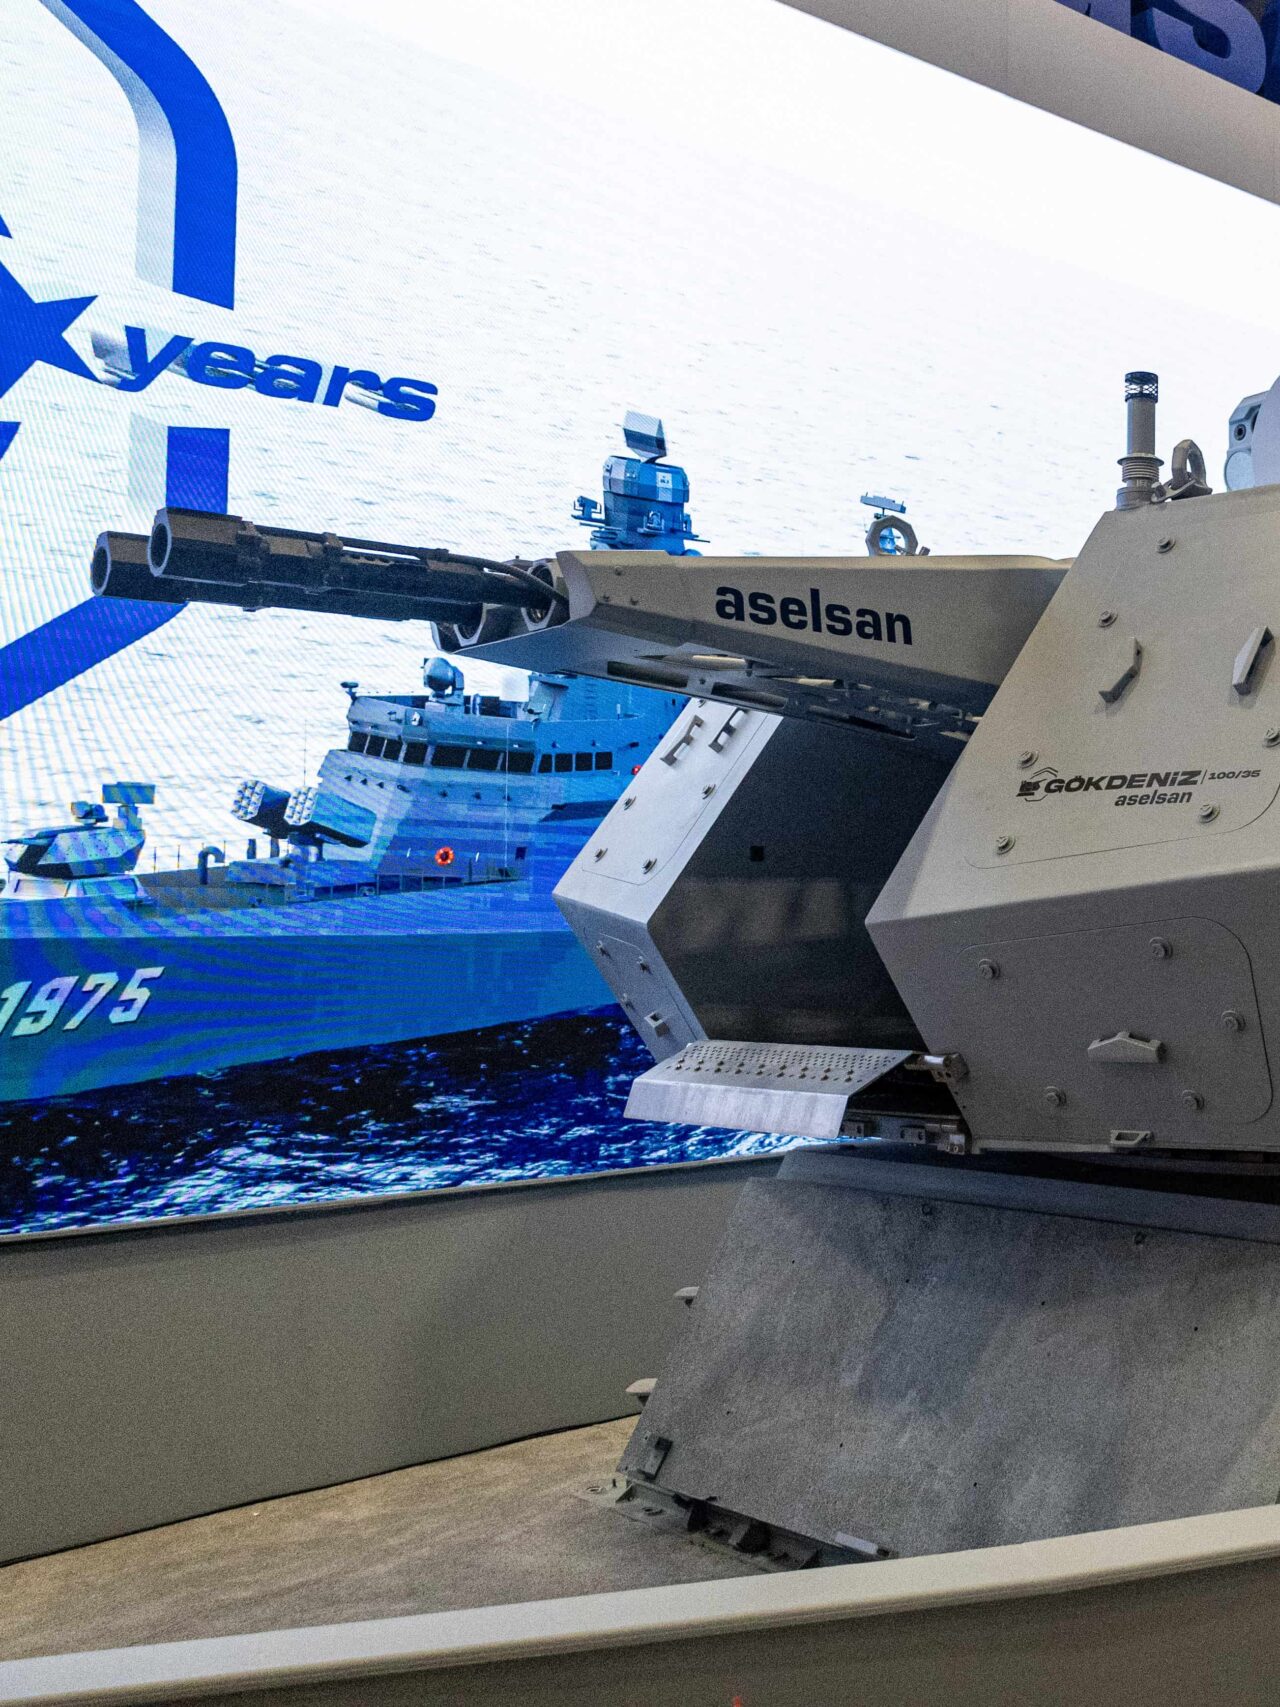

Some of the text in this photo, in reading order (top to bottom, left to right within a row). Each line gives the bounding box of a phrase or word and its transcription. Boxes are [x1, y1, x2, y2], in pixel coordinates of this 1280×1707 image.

[113, 325, 439, 422] years
[715, 586, 913, 646] aselsan
[1114, 789, 1193, 807] aselsan
[1208, 769, 1262, 781] 100/35
[0, 966, 165, 1038] 1975
